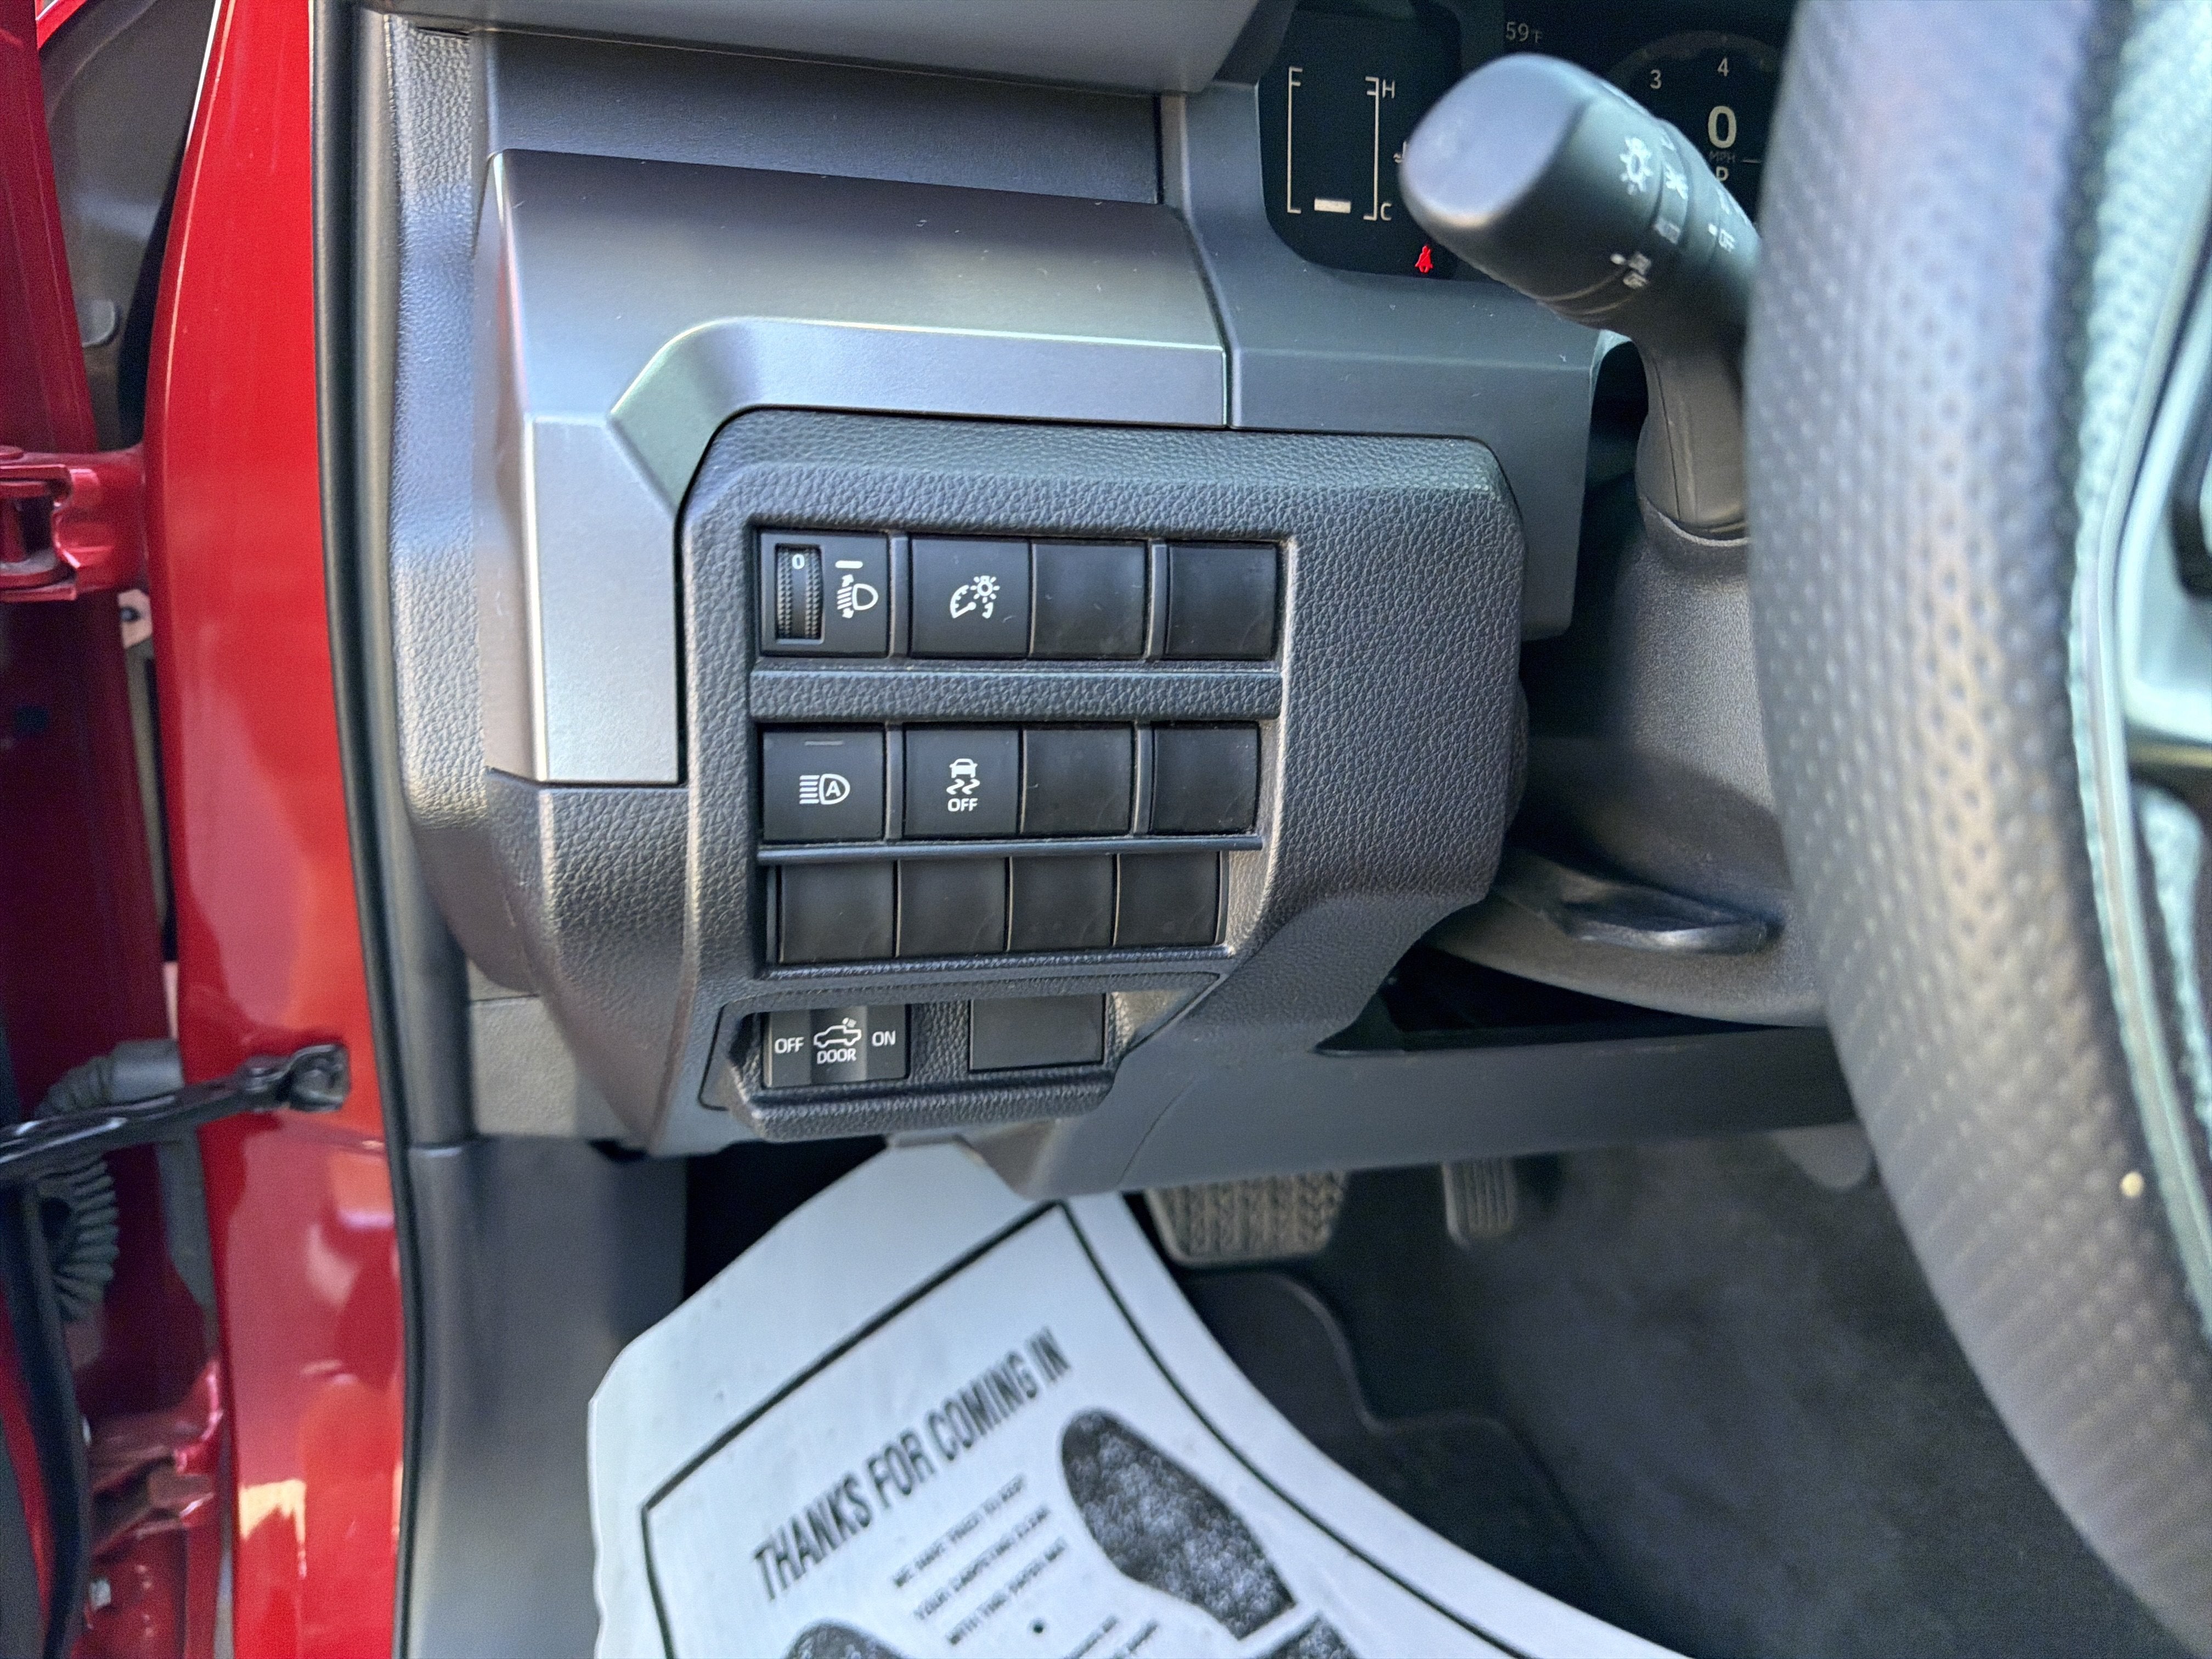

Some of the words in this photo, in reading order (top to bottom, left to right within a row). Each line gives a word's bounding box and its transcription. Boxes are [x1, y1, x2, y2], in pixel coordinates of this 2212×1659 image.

[1717, 57, 1729, 77] 4
[1381, 78, 1396, 99] H
[1650, 69, 1662, 89] 3
[1707, 105, 1737, 149] 0
[1380, 201, 1392, 221] C
[792, 554, 805, 570] 0
[947, 798, 979, 812] OFF
[774, 1036, 805, 1054] OFF
[871, 1030, 896, 1047] ON
[816, 1048, 857, 1065] DOOR
[754, 1470, 873, 1601] THANKS
[865, 1427, 936, 1509] FOR
[924, 1348, 1039, 1461] COMING
[1025, 1325, 1072, 1383] IN
